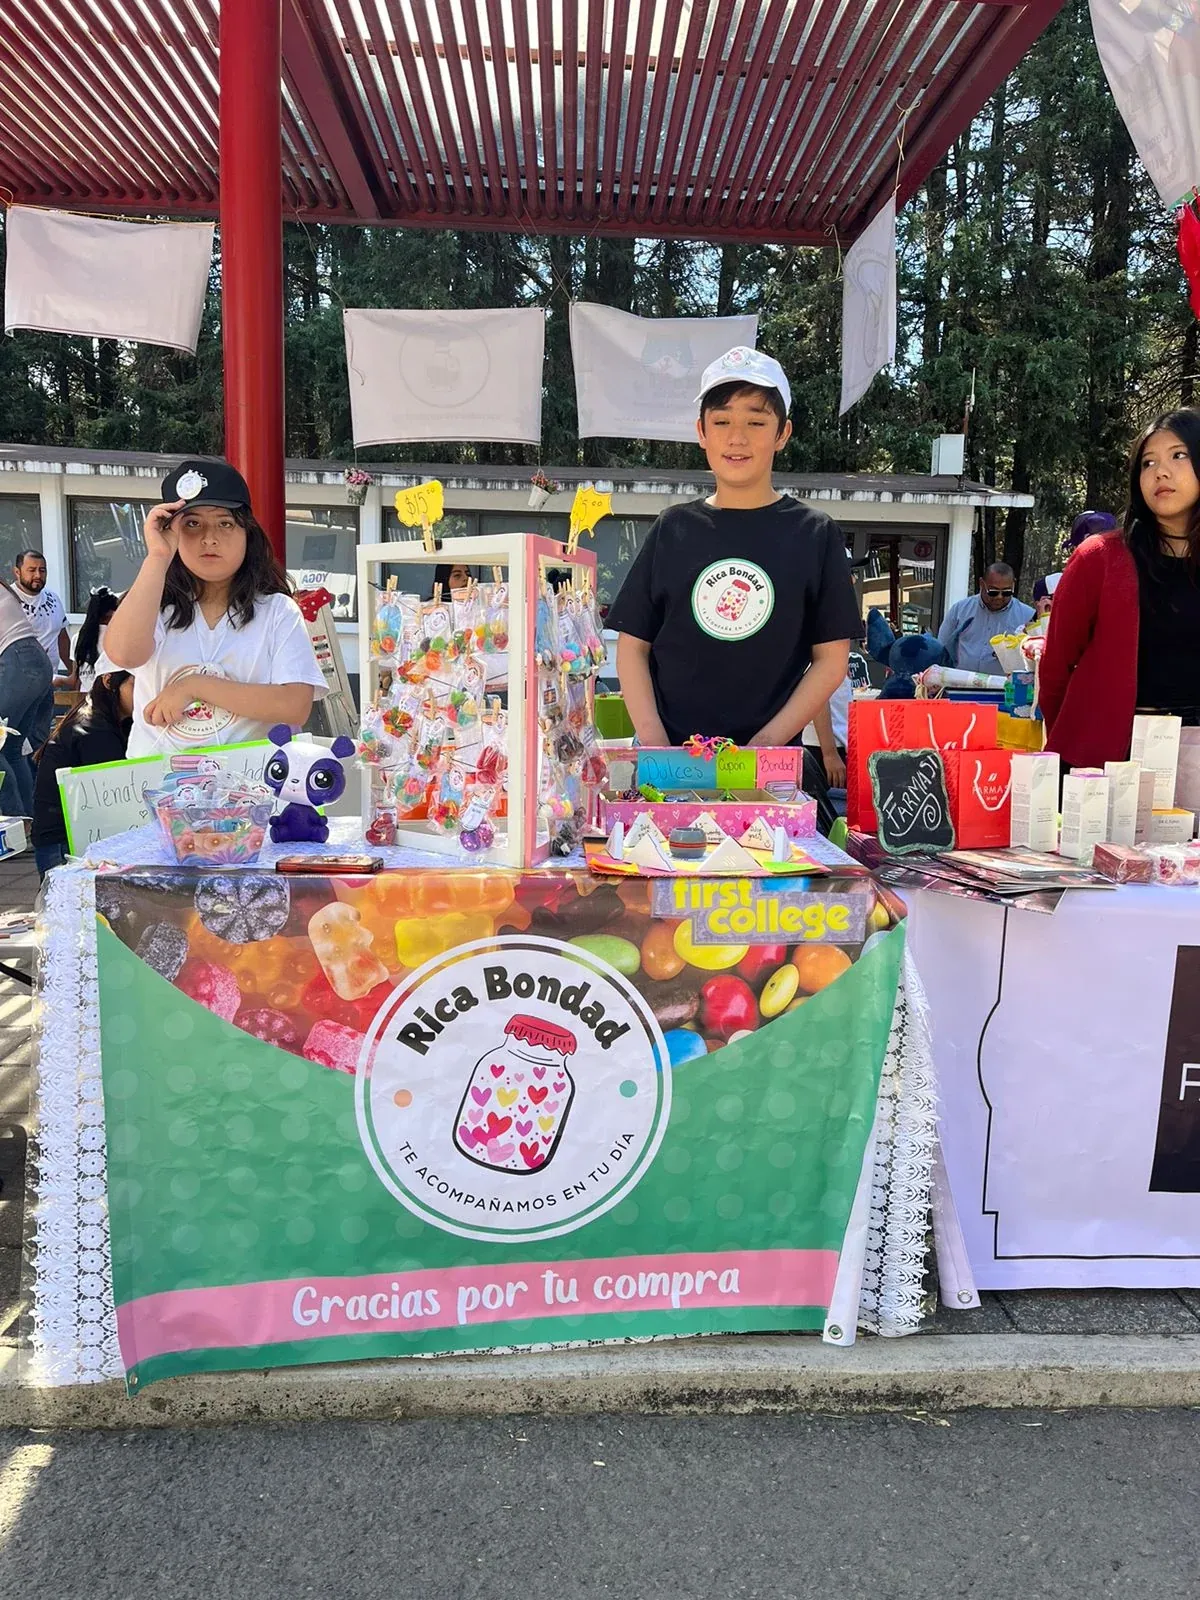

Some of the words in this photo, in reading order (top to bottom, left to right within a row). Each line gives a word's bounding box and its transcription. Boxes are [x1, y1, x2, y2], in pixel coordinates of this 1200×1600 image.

[705, 570, 727, 588] Rica
[729, 566, 764, 592] Bondad
[643, 754, 704, 780] Dulces
[719, 755, 746, 774] Cupón
[759, 754, 795, 773] Bondad
[882, 754, 938, 830] FARMASI
[672, 877, 752, 909] first
[707, 899, 850, 940] college
[396, 985, 479, 1056] Rica
[483, 965, 632, 1050] Bondad
[399, 1141, 418, 1164] TE
[415, 1166, 557, 1212] ACOMPAÑAMOS
[563, 1181, 587, 1201] EN
[588, 1162, 611, 1183] TU
[610, 1133, 635, 1162] DÍA
[292, 1283, 441, 1327] Gracias
[457, 1279, 529, 1325] por
[540, 1269, 580, 1305] tu
[593, 1268, 740, 1309] compra
